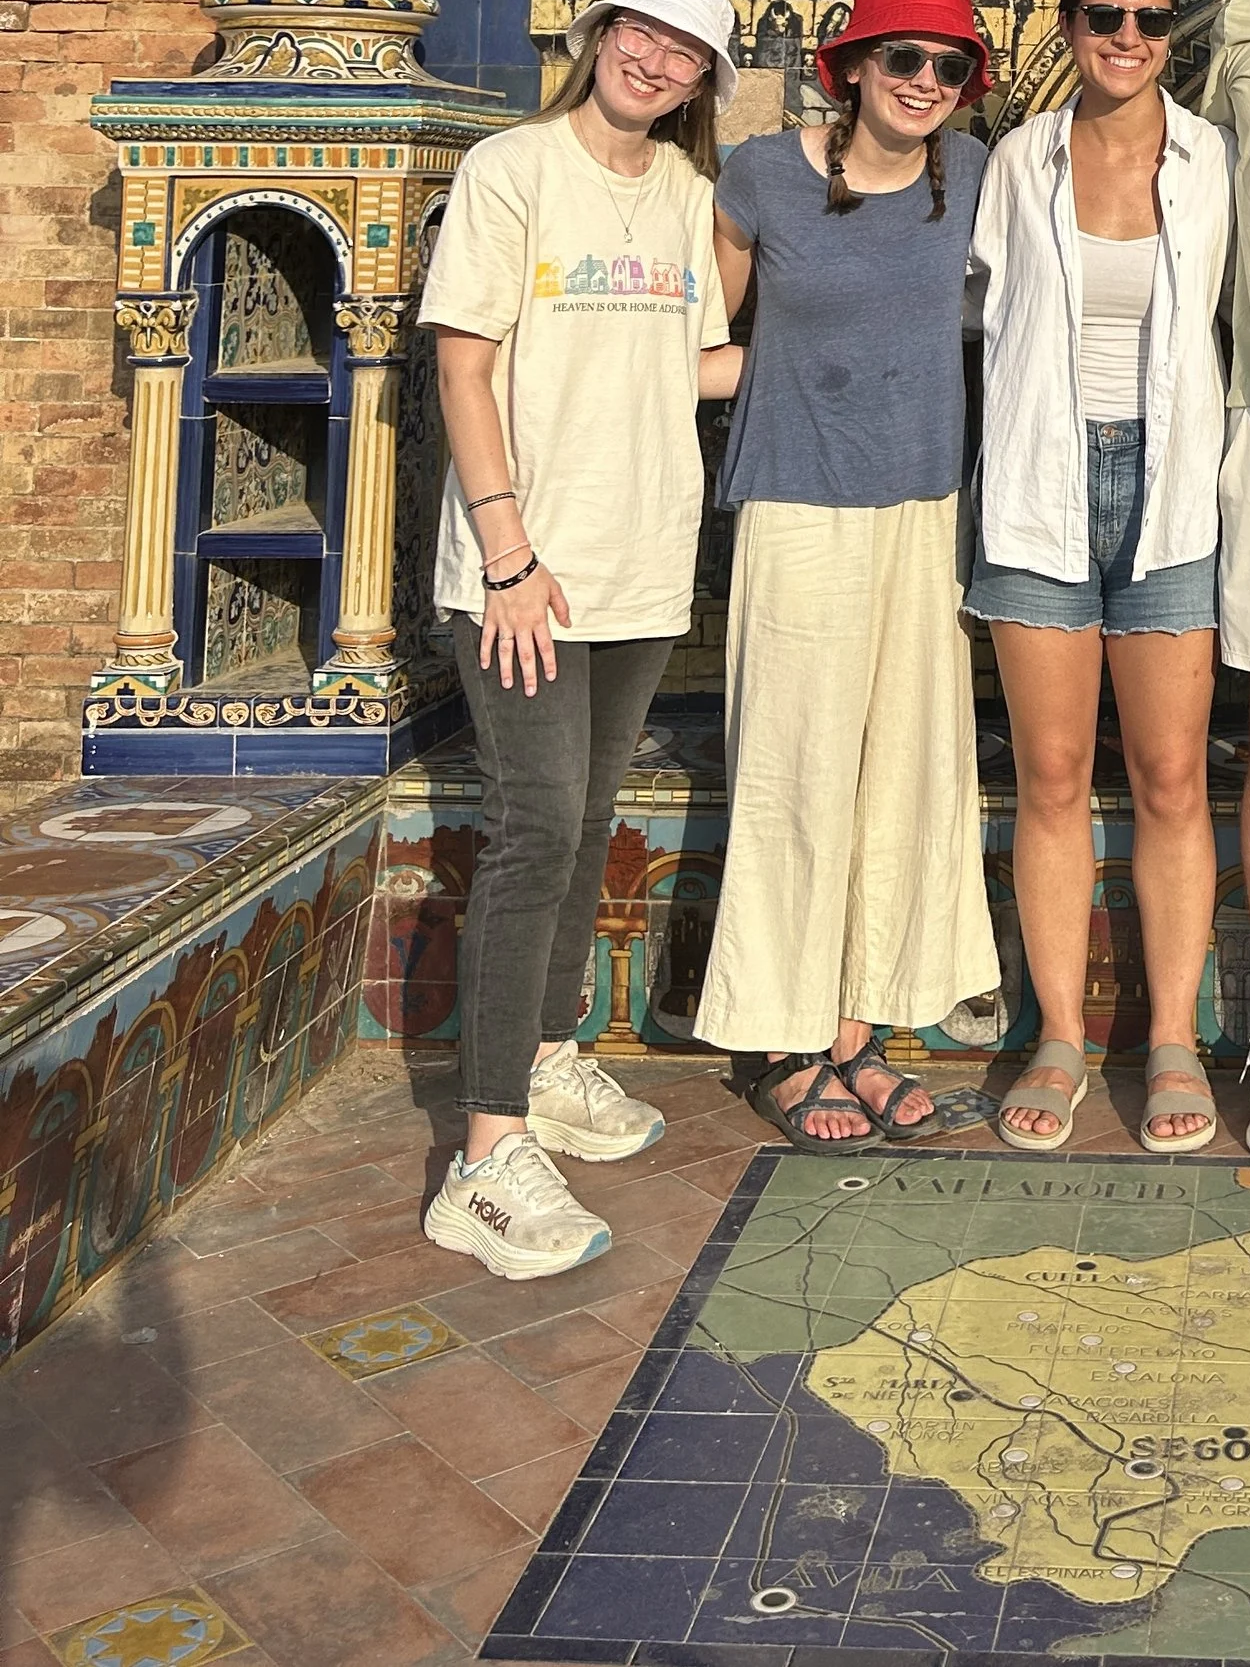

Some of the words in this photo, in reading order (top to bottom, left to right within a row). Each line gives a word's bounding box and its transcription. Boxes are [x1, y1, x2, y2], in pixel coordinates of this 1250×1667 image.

[552, 302, 595, 313] HEAVEN
[596, 302, 605, 312] IS
[607, 302, 627, 313] OUR
[629, 302, 657, 313] HOME
[893, 1176, 1187, 1200] VALLADOLID
[468, 1191, 513, 1236] HOKA
[1125, 1305, 1233, 1318] LASTRAS
[1006, 1322, 1133, 1335] PINAREJOS
[1028, 1344, 1217, 1360] FUENTEPELAYO
[880, 1378, 957, 1390] MARIA
[1090, 1370, 1226, 1385] ESCALONA
[863, 1390, 936, 1401] NIEVA
[895, 1419, 976, 1432] MARTIN
[1186, 1502, 1214, 1516] LA
[772, 1563, 961, 1593] AVILA
[984, 1566, 1006, 1578] EL
[1018, 1567, 1104, 1580] ESPINAR
